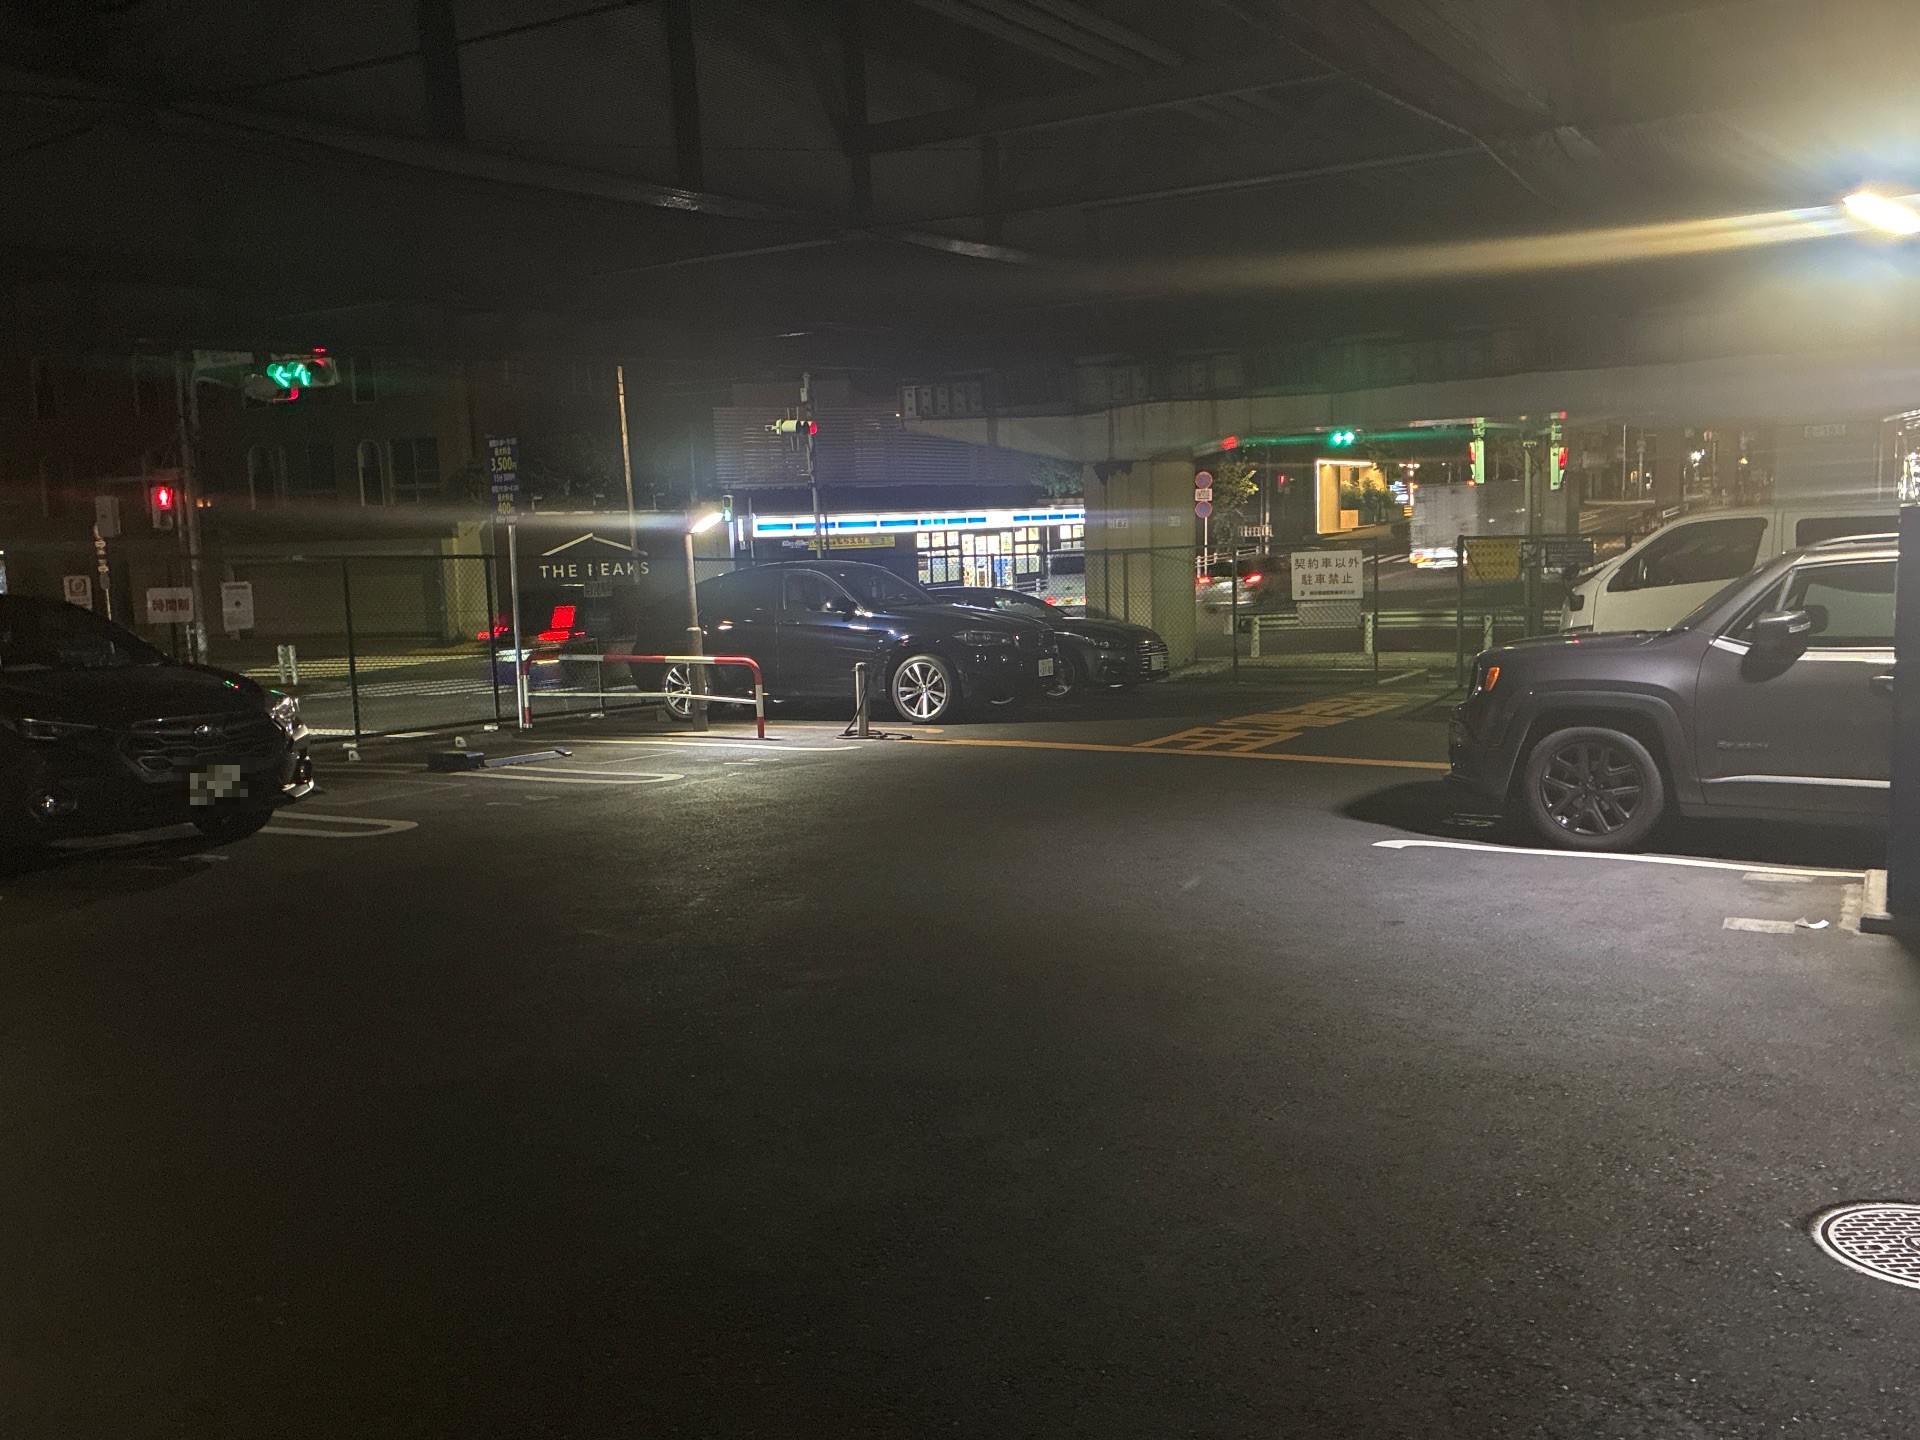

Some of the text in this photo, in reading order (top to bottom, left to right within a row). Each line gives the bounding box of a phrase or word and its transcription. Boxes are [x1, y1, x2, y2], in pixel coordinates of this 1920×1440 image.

[1294, 556, 1360, 570] 契約車以外
[539, 564, 577, 579] THE
[1301, 573, 1354, 586] 駐車禁止
